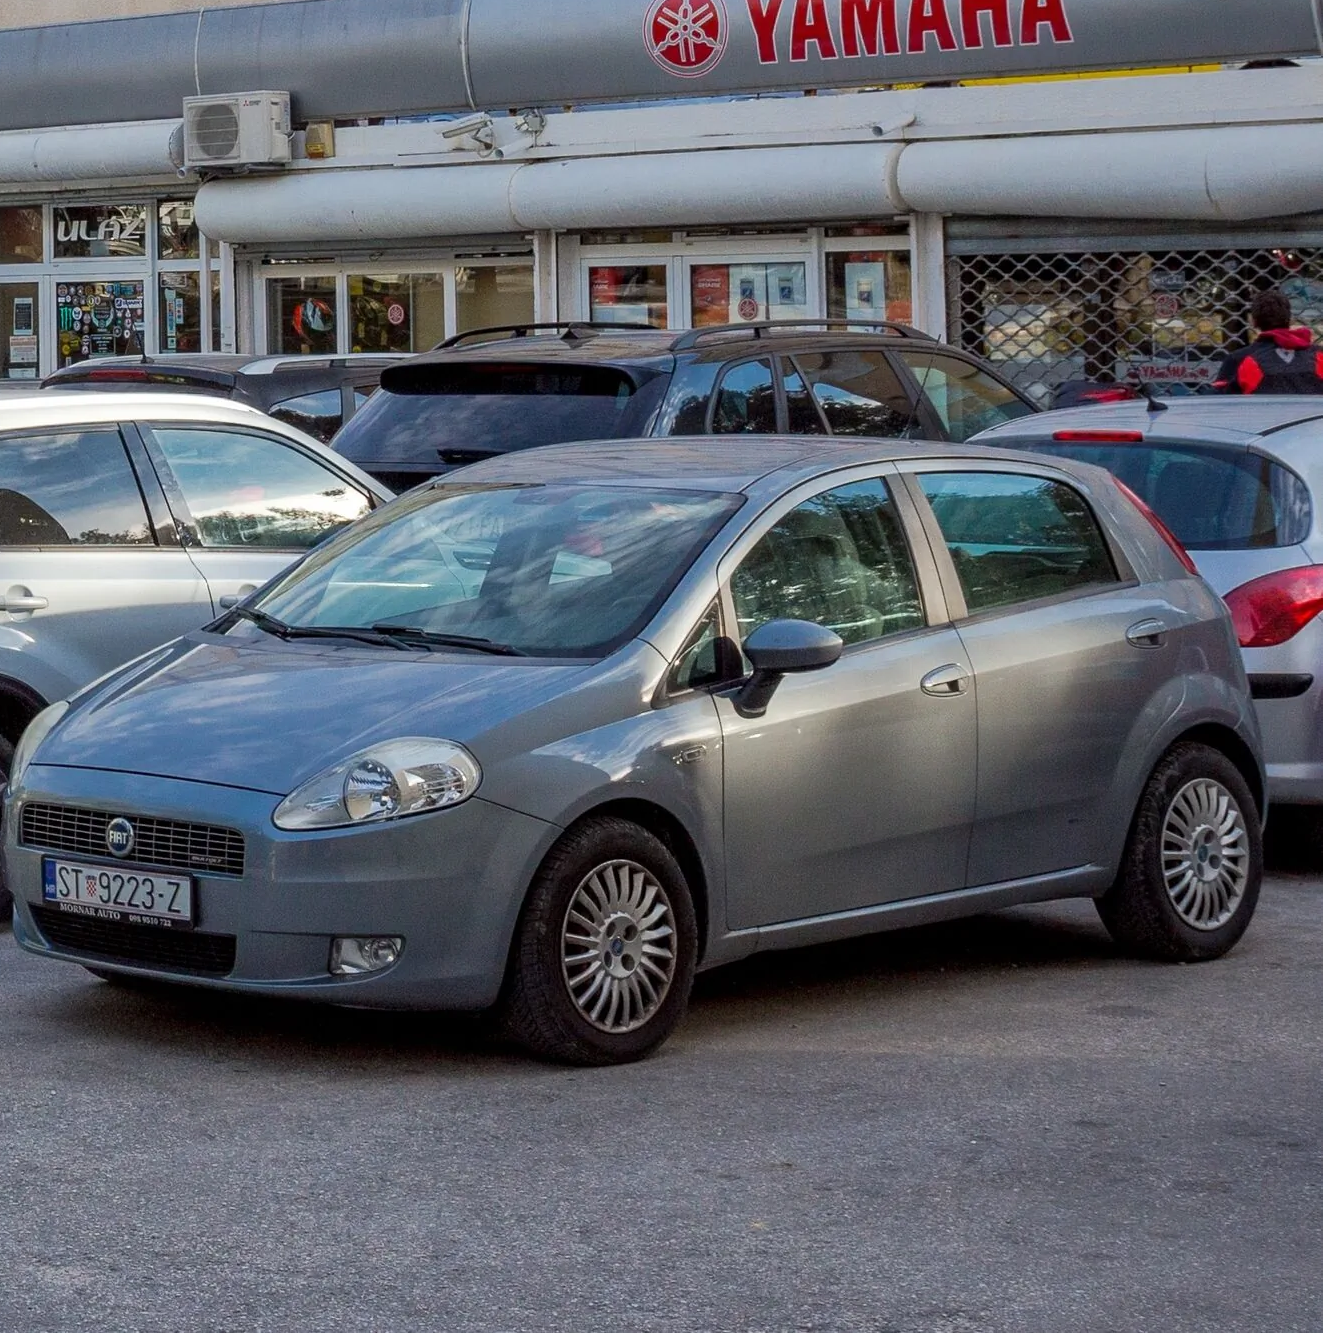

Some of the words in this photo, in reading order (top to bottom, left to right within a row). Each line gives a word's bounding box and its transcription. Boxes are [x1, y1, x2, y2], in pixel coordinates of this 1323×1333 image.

[109, 830, 128, 845] FIAT
[58, 866, 83, 900] ST
[98, 872, 182, 914] 9223-Z
[59, 902, 96, 917] MORNAR
[97, 908, 121, 920] AUTO
